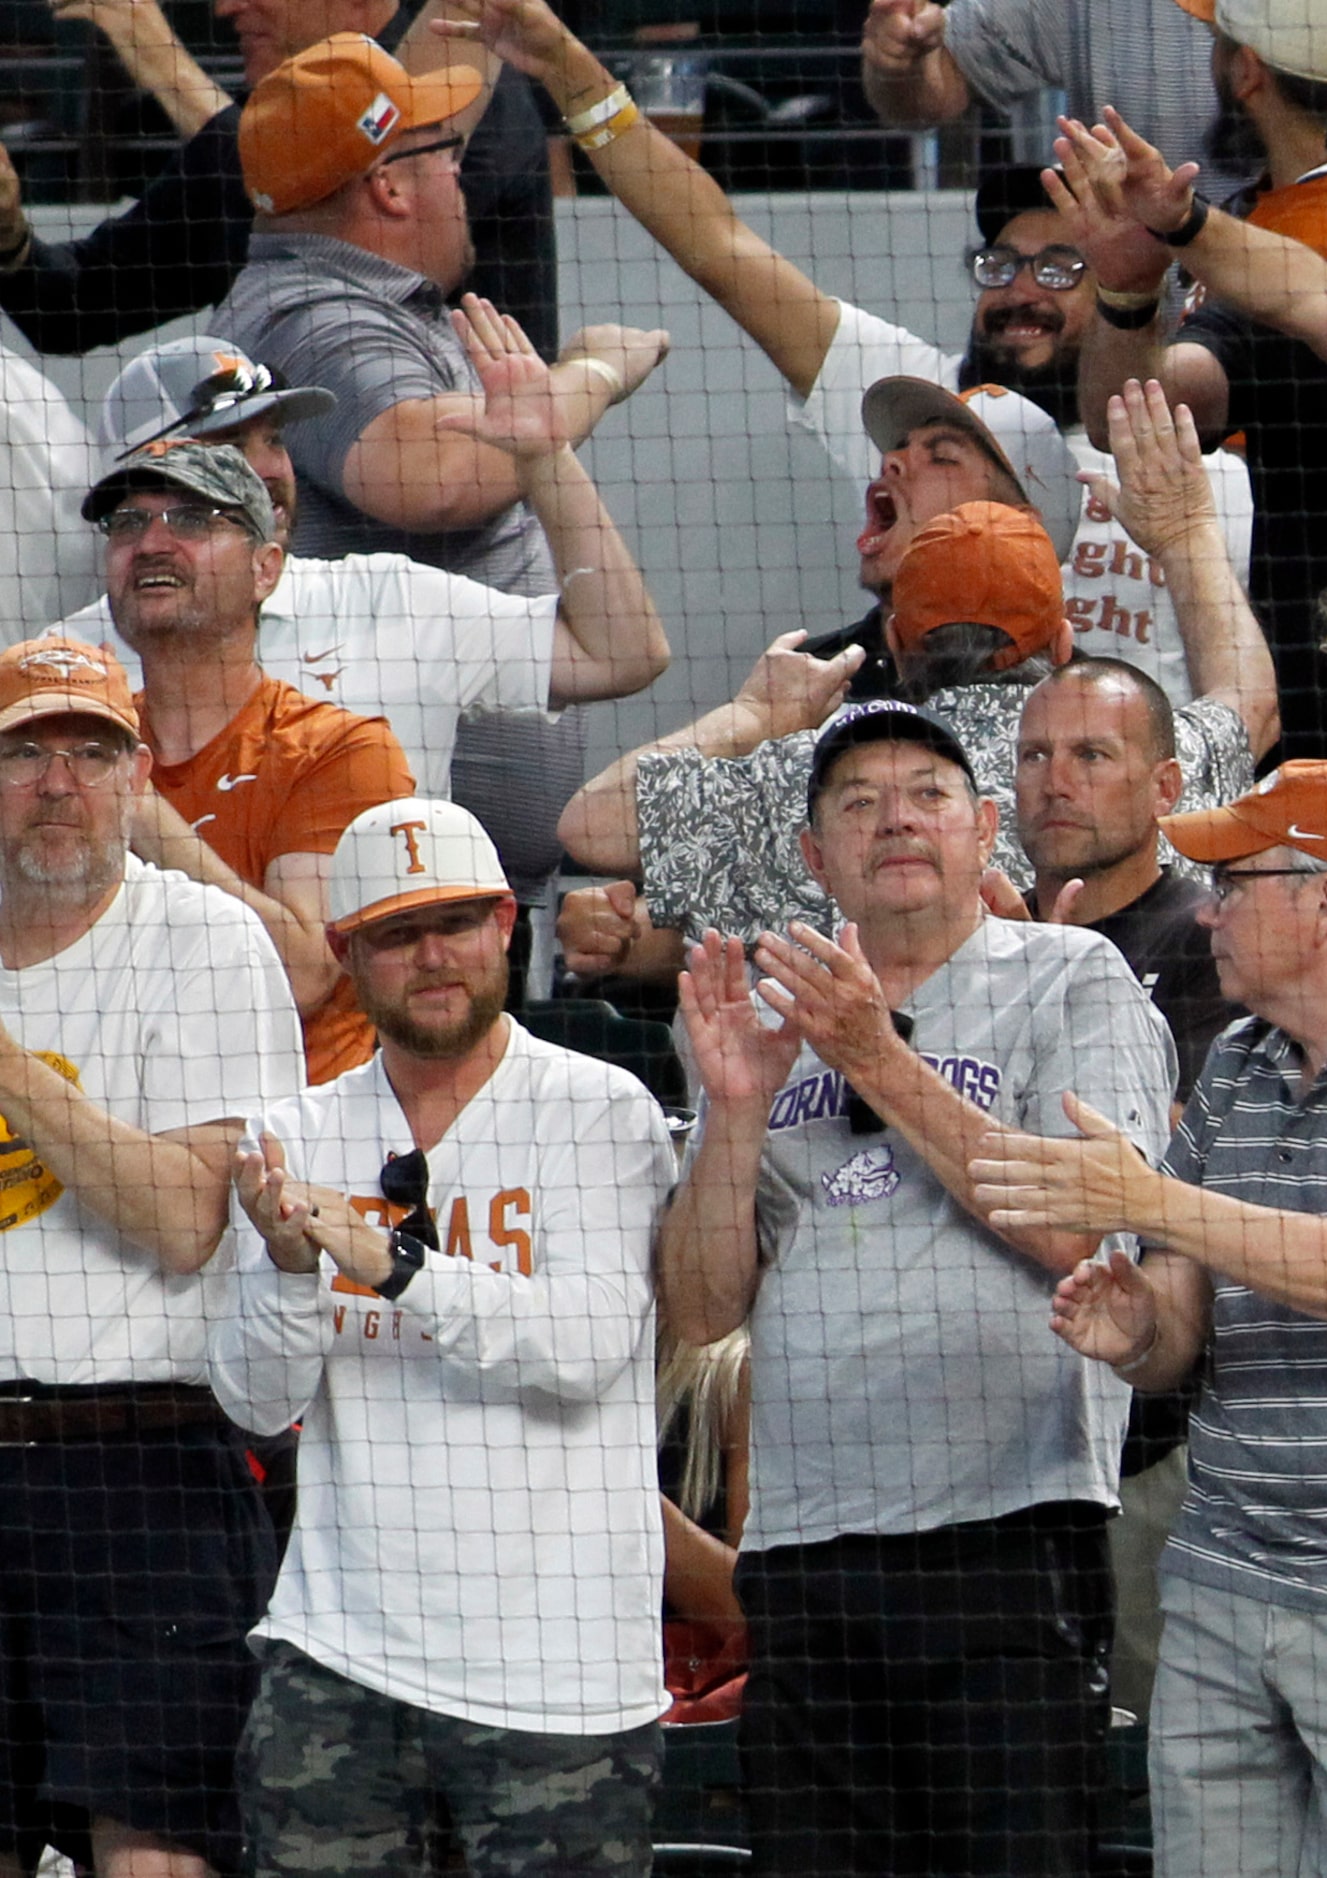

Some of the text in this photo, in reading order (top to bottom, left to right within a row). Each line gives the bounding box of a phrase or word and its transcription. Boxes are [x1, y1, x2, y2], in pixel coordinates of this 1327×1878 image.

[1073, 540, 1166, 588] ght
[1065, 595, 1152, 644] ght
[389, 820, 427, 875] T
